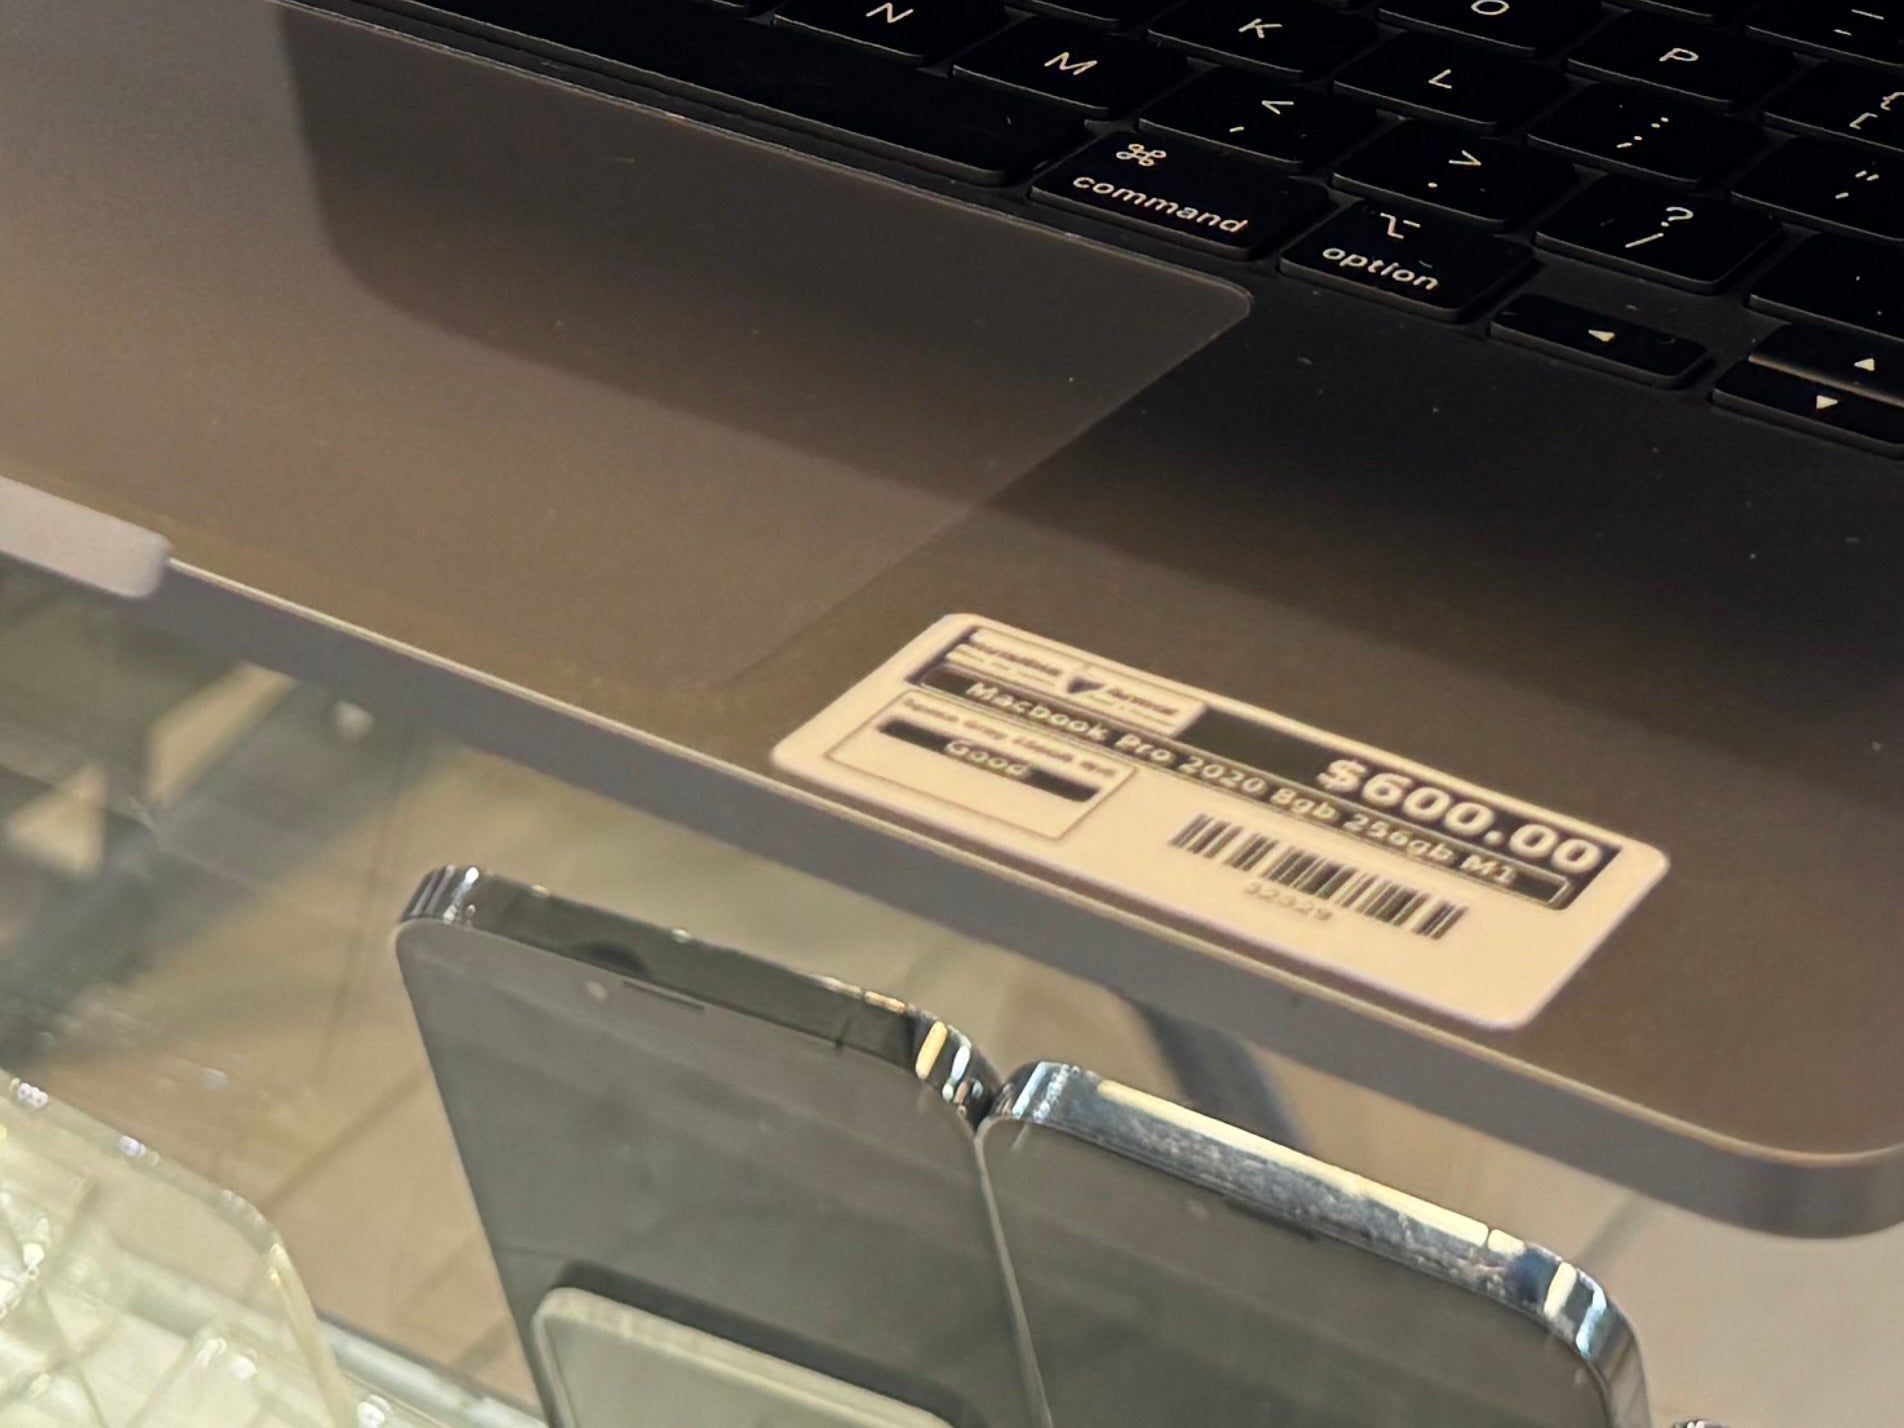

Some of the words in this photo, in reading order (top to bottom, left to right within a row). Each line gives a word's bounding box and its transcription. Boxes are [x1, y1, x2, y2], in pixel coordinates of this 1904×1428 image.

[865, 2, 914, 24] N
[1238, 17, 1283, 39] K
[1044, 51, 1098, 76] M
[1658, 47, 1699, 62] P
[1428, 68, 1453, 90] L
[1072, 174, 1250, 235] command
[1321, 245, 1441, 292] option
[944, 739, 1033, 778] Good
[965, 682, 1110, 741] Macbook
[1114, 733, 1176, 764] Pro
[1179, 755, 1267, 795] 2020
[1271, 785, 1341, 823] 8gb
[1343, 813, 1456, 863] 256gb
[1460, 851, 1519, 884] M1
[1317, 758, 1603, 873] $600.00
